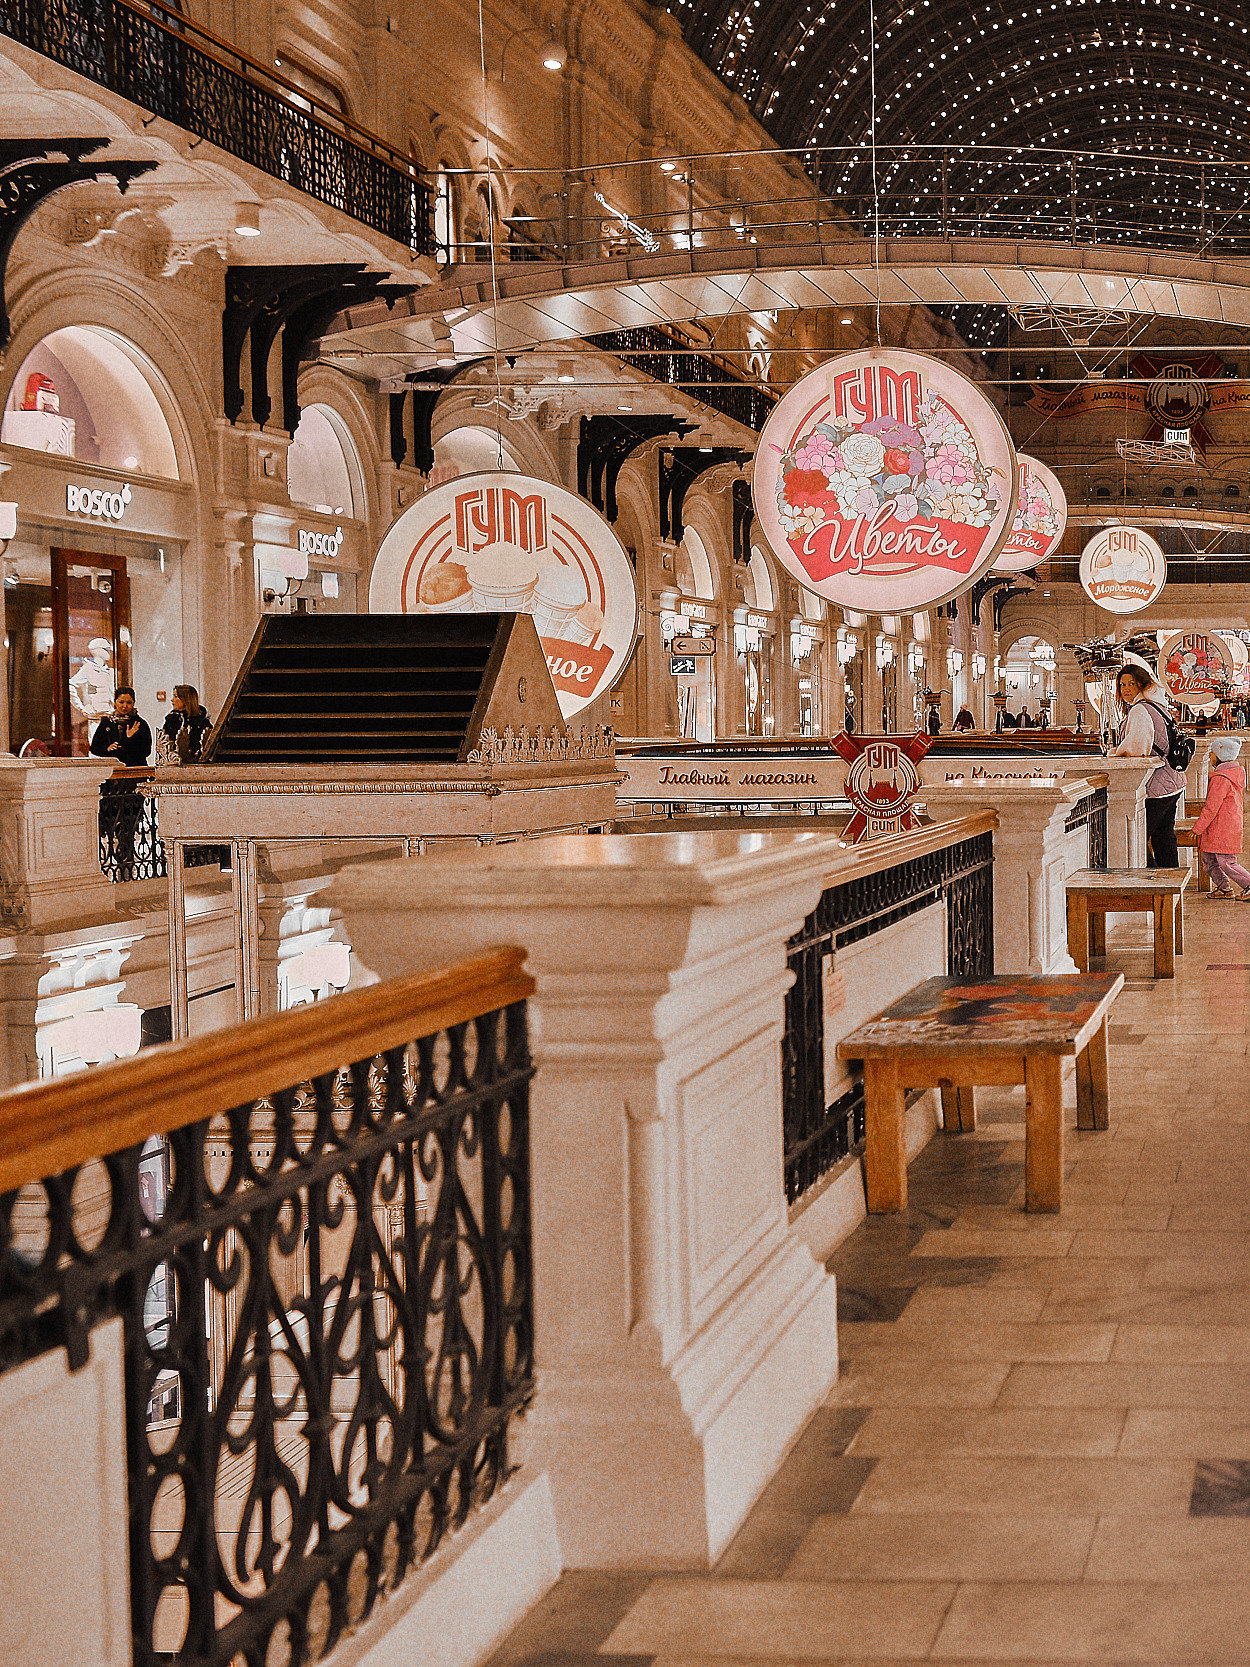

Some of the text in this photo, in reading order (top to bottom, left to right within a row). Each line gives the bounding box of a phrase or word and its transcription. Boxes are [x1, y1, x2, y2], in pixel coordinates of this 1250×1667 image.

[833, 366, 924, 428] ГУМ
[1037, 391, 1140, 411] Главный магазин
[1212, 398, 1226, 406] на
[1168, 431, 1188, 440] GUM
[66, 484, 124, 520] BOSCO
[455, 487, 547, 554] ГУМ
[298, 529, 339, 558] BOSCO
[803, 499, 967, 575] Цветы
[1006, 532, 1044, 550] еты
[1108, 531, 1138, 553] ГУМ
[1094, 583, 1150, 598] Мороженое
[1182, 634, 1208, 652] ГУМ
[1172, 672, 1215, 694] Цвет
[867, 745, 899, 769] ГУМ
[658, 766, 818, 786] Главный магазин
[853, 795, 909, 817] КРАСНАЯ ПЛОЩА
[871, 820, 896, 831] GUM
